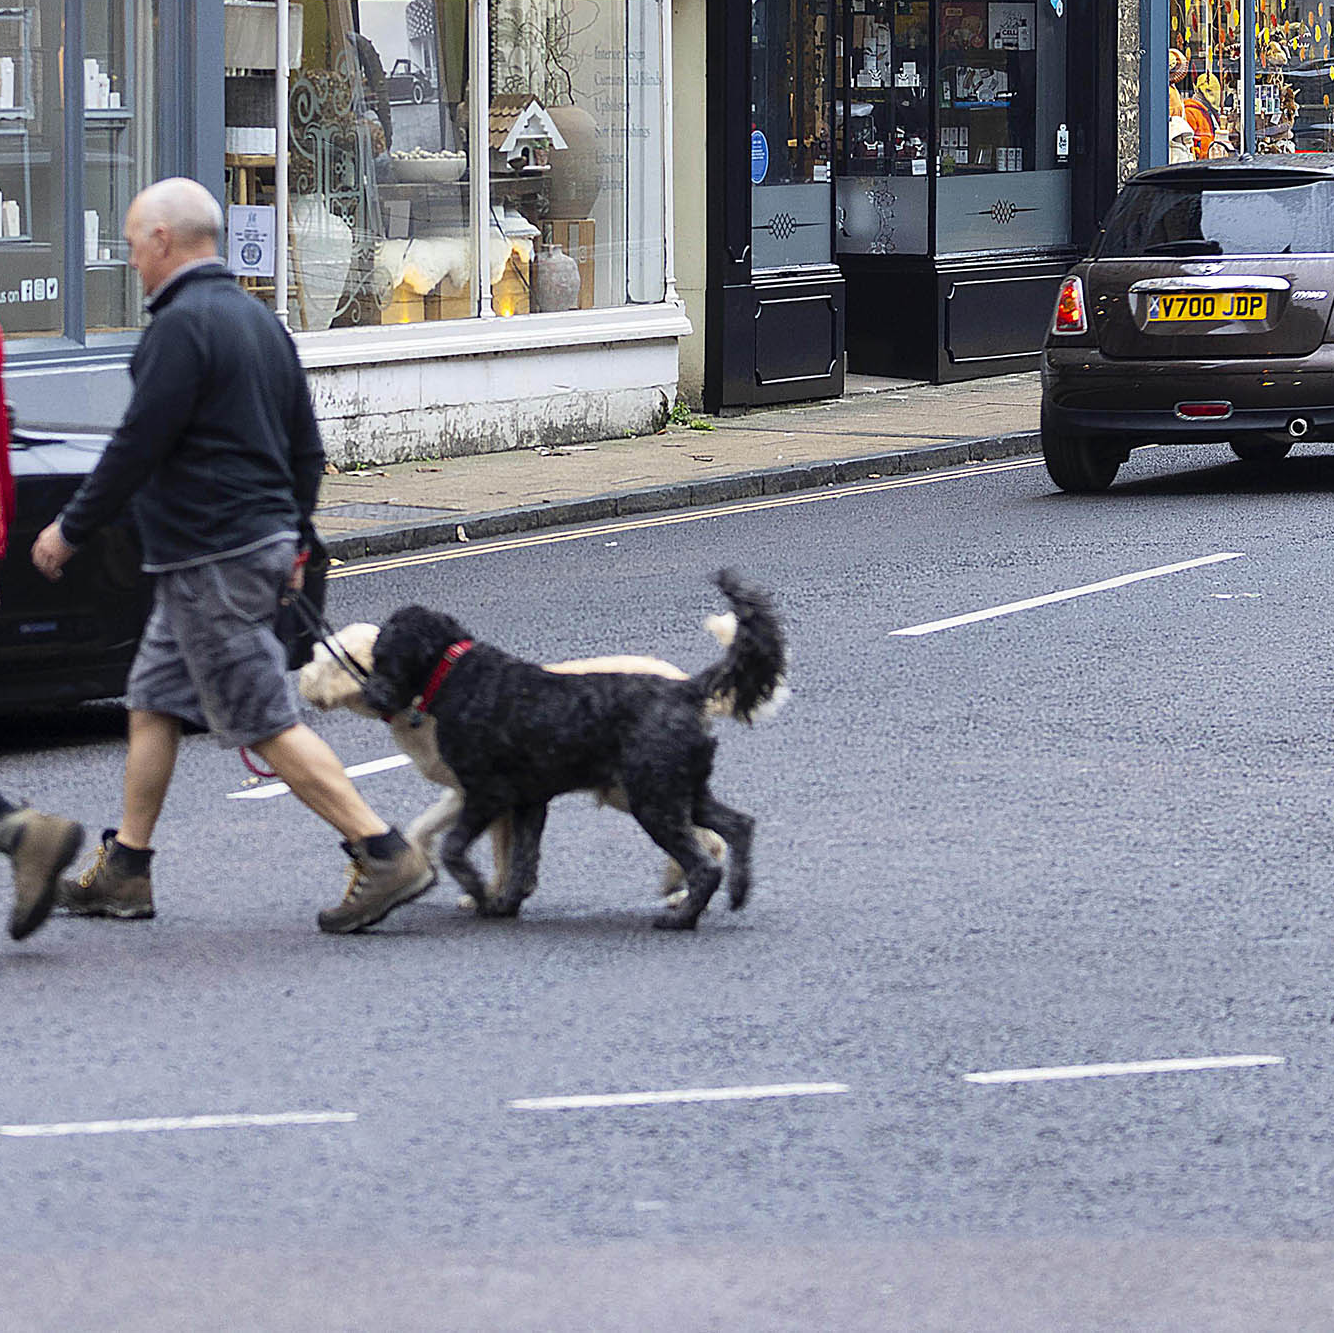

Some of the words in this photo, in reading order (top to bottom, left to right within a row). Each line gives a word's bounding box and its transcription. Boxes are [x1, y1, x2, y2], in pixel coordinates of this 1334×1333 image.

[8, 289, 20, 304] on
[1161, 296, 1216, 318] V700
[1222, 295, 1264, 317] JDP
